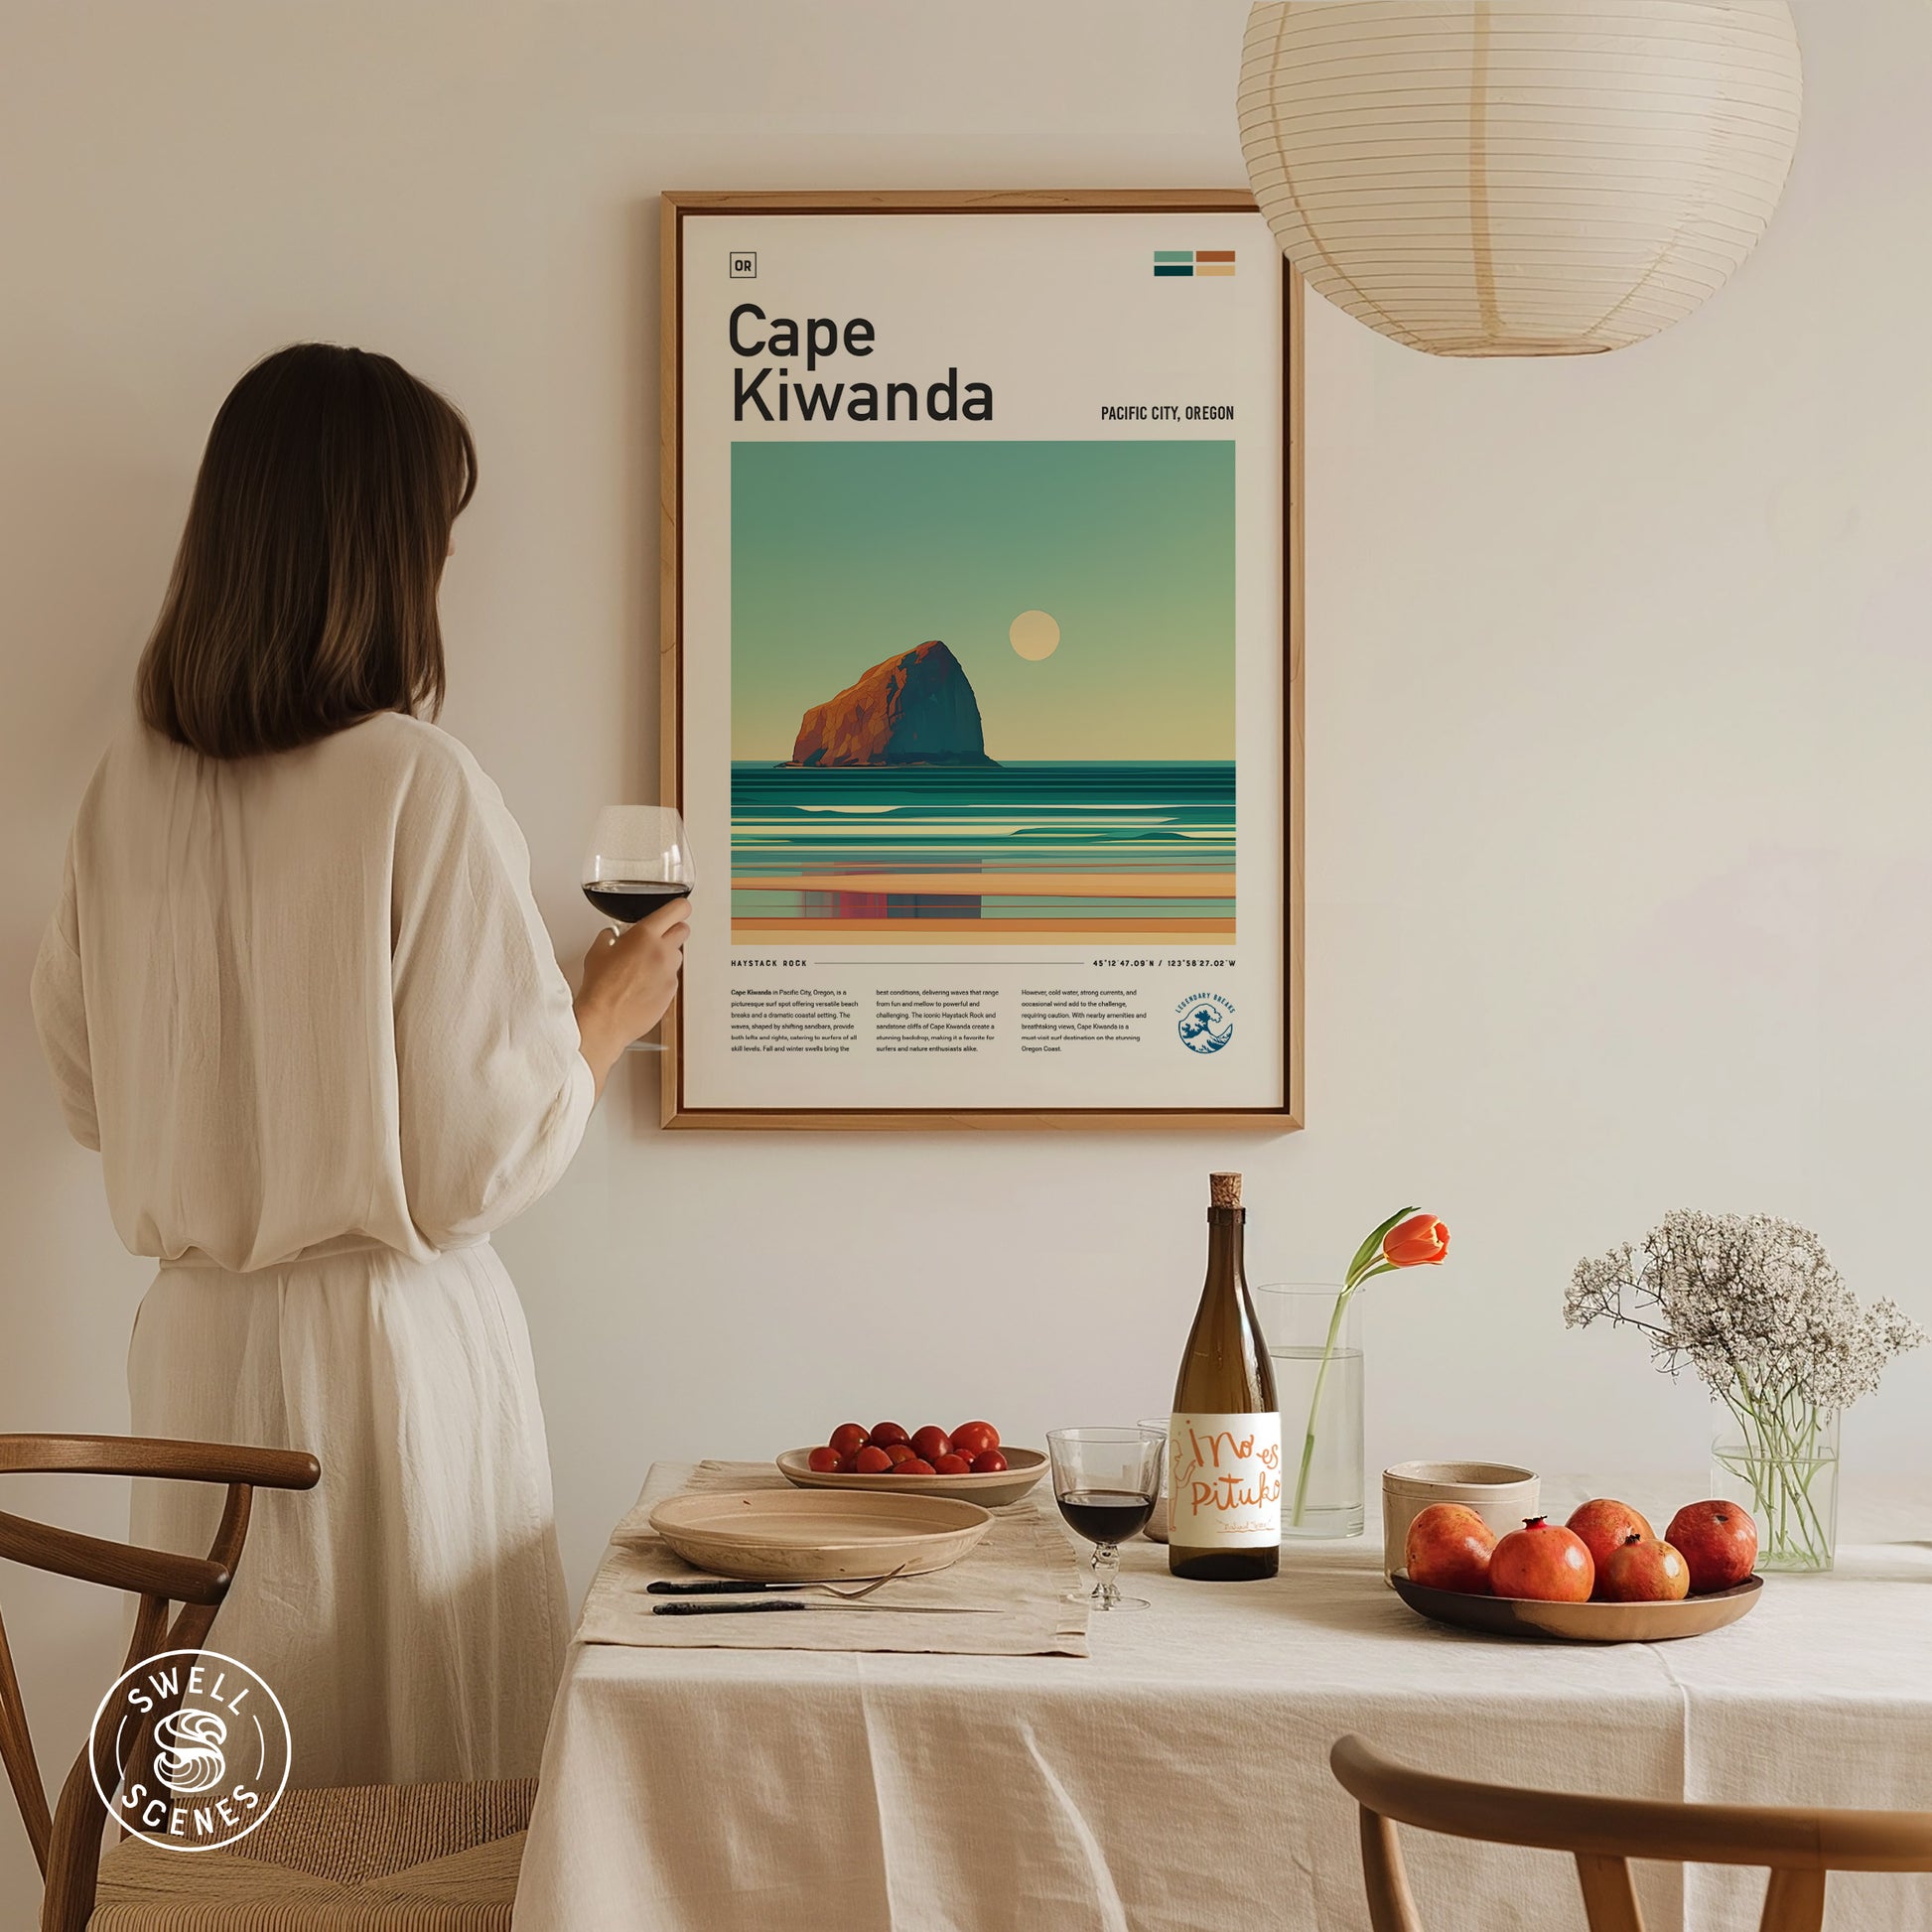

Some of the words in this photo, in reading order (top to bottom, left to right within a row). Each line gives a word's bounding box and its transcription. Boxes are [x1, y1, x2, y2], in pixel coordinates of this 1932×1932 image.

[735, 259, 752, 272] OR
[729, 303, 876, 371] Cape
[734, 366, 994, 422] Kiwanda
[1101, 406, 1148, 421] PACIFIC
[1152, 406, 1181, 423] CITY,
[1184, 406, 1234, 421] OREGON
[1175, 993, 1210, 1013] LEGENDARY
[1213, 994, 1235, 1013] BREAKS
